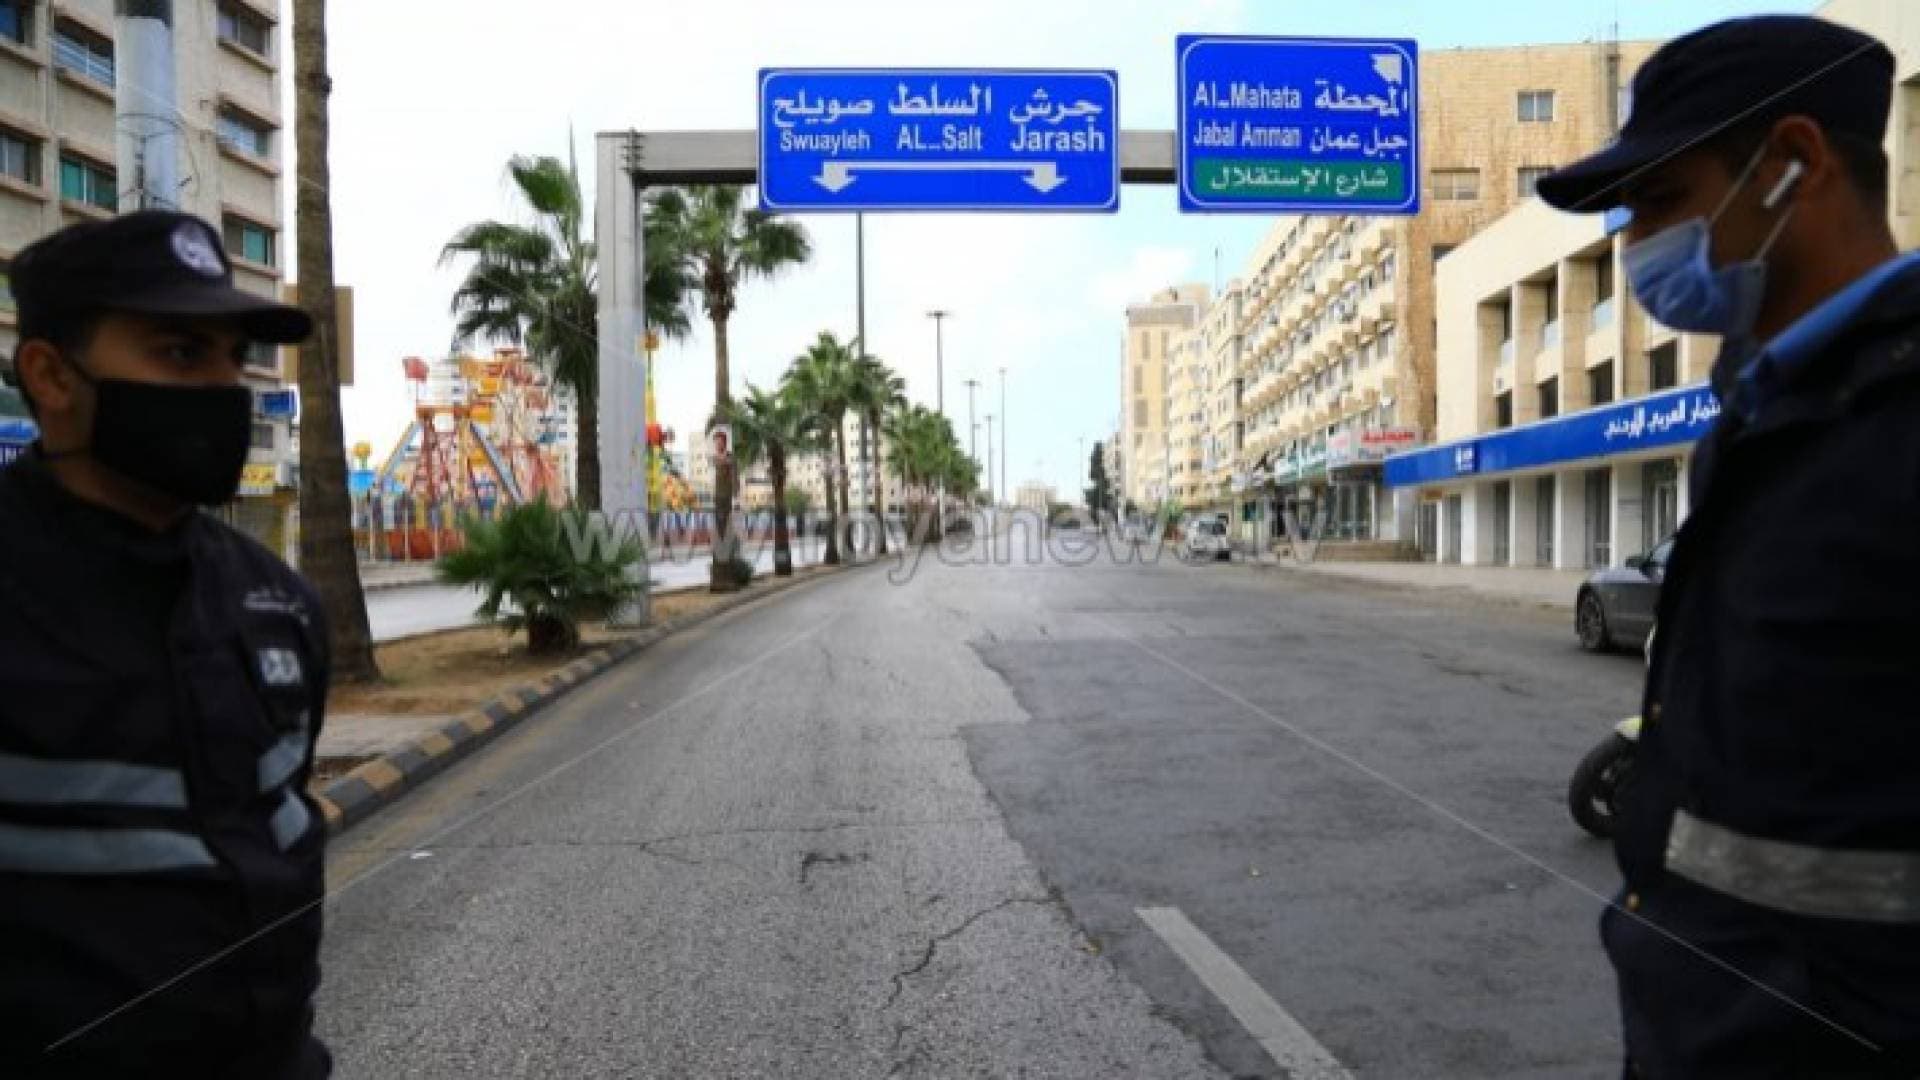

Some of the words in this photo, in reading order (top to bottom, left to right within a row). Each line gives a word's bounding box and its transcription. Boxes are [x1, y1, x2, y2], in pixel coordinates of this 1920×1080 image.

[773, 86, 874, 127] صويلح
[888, 82, 992, 115] السلط
[1009, 85, 1103, 123] جرش
[1314, 79, 1408, 117] المحطة
[780, 128, 870, 155] Swuayleh
[1010, 122, 1105, 152] Jarash
[1194, 121, 1236, 147] Jabal
[1242, 121, 1301, 147] Amman
[1310, 125, 1360, 154] عمان
[1363, 125, 1408, 159] جبل
[1336, 166, 1389, 196] شارع
